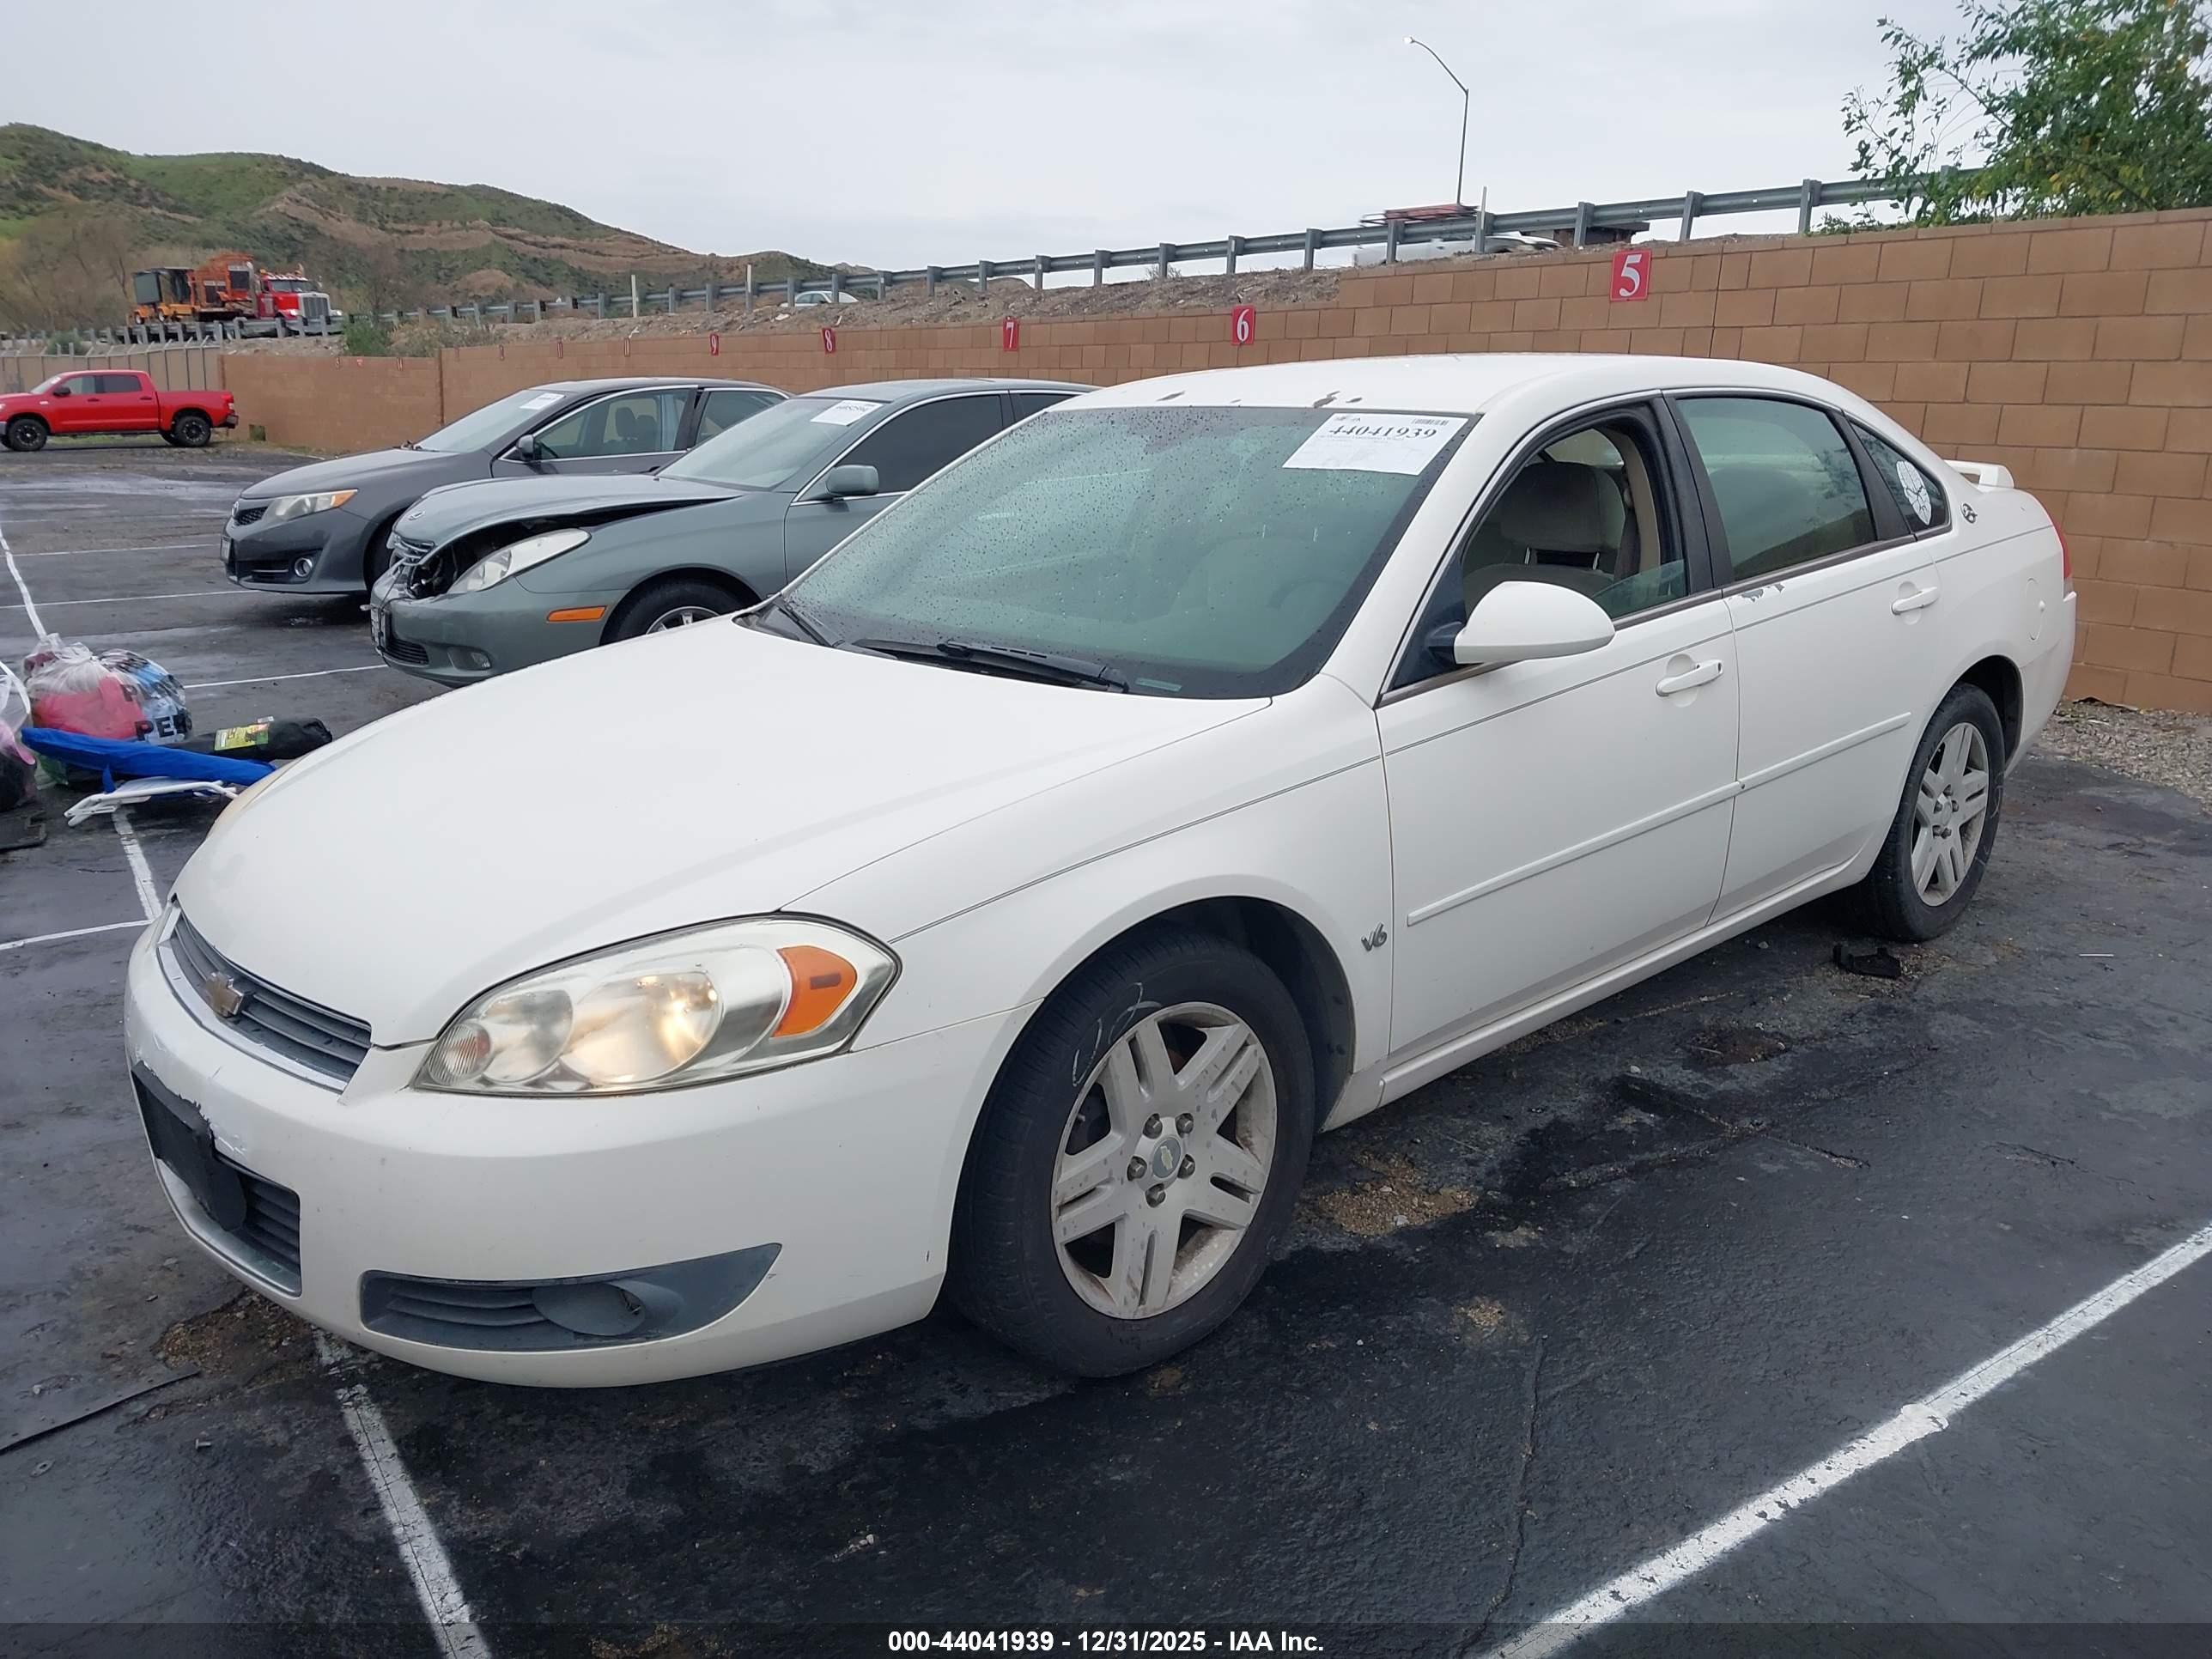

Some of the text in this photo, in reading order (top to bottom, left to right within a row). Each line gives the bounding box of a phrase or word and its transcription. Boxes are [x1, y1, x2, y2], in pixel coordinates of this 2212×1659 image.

[1619, 253, 1643, 297] 5
[1006, 321, 1014, 349] 7
[1237, 308, 1250, 343] 6
[711, 335, 716, 355] 9
[824, 329, 833, 352] 8
[1328, 424, 1437, 440] 44041939
